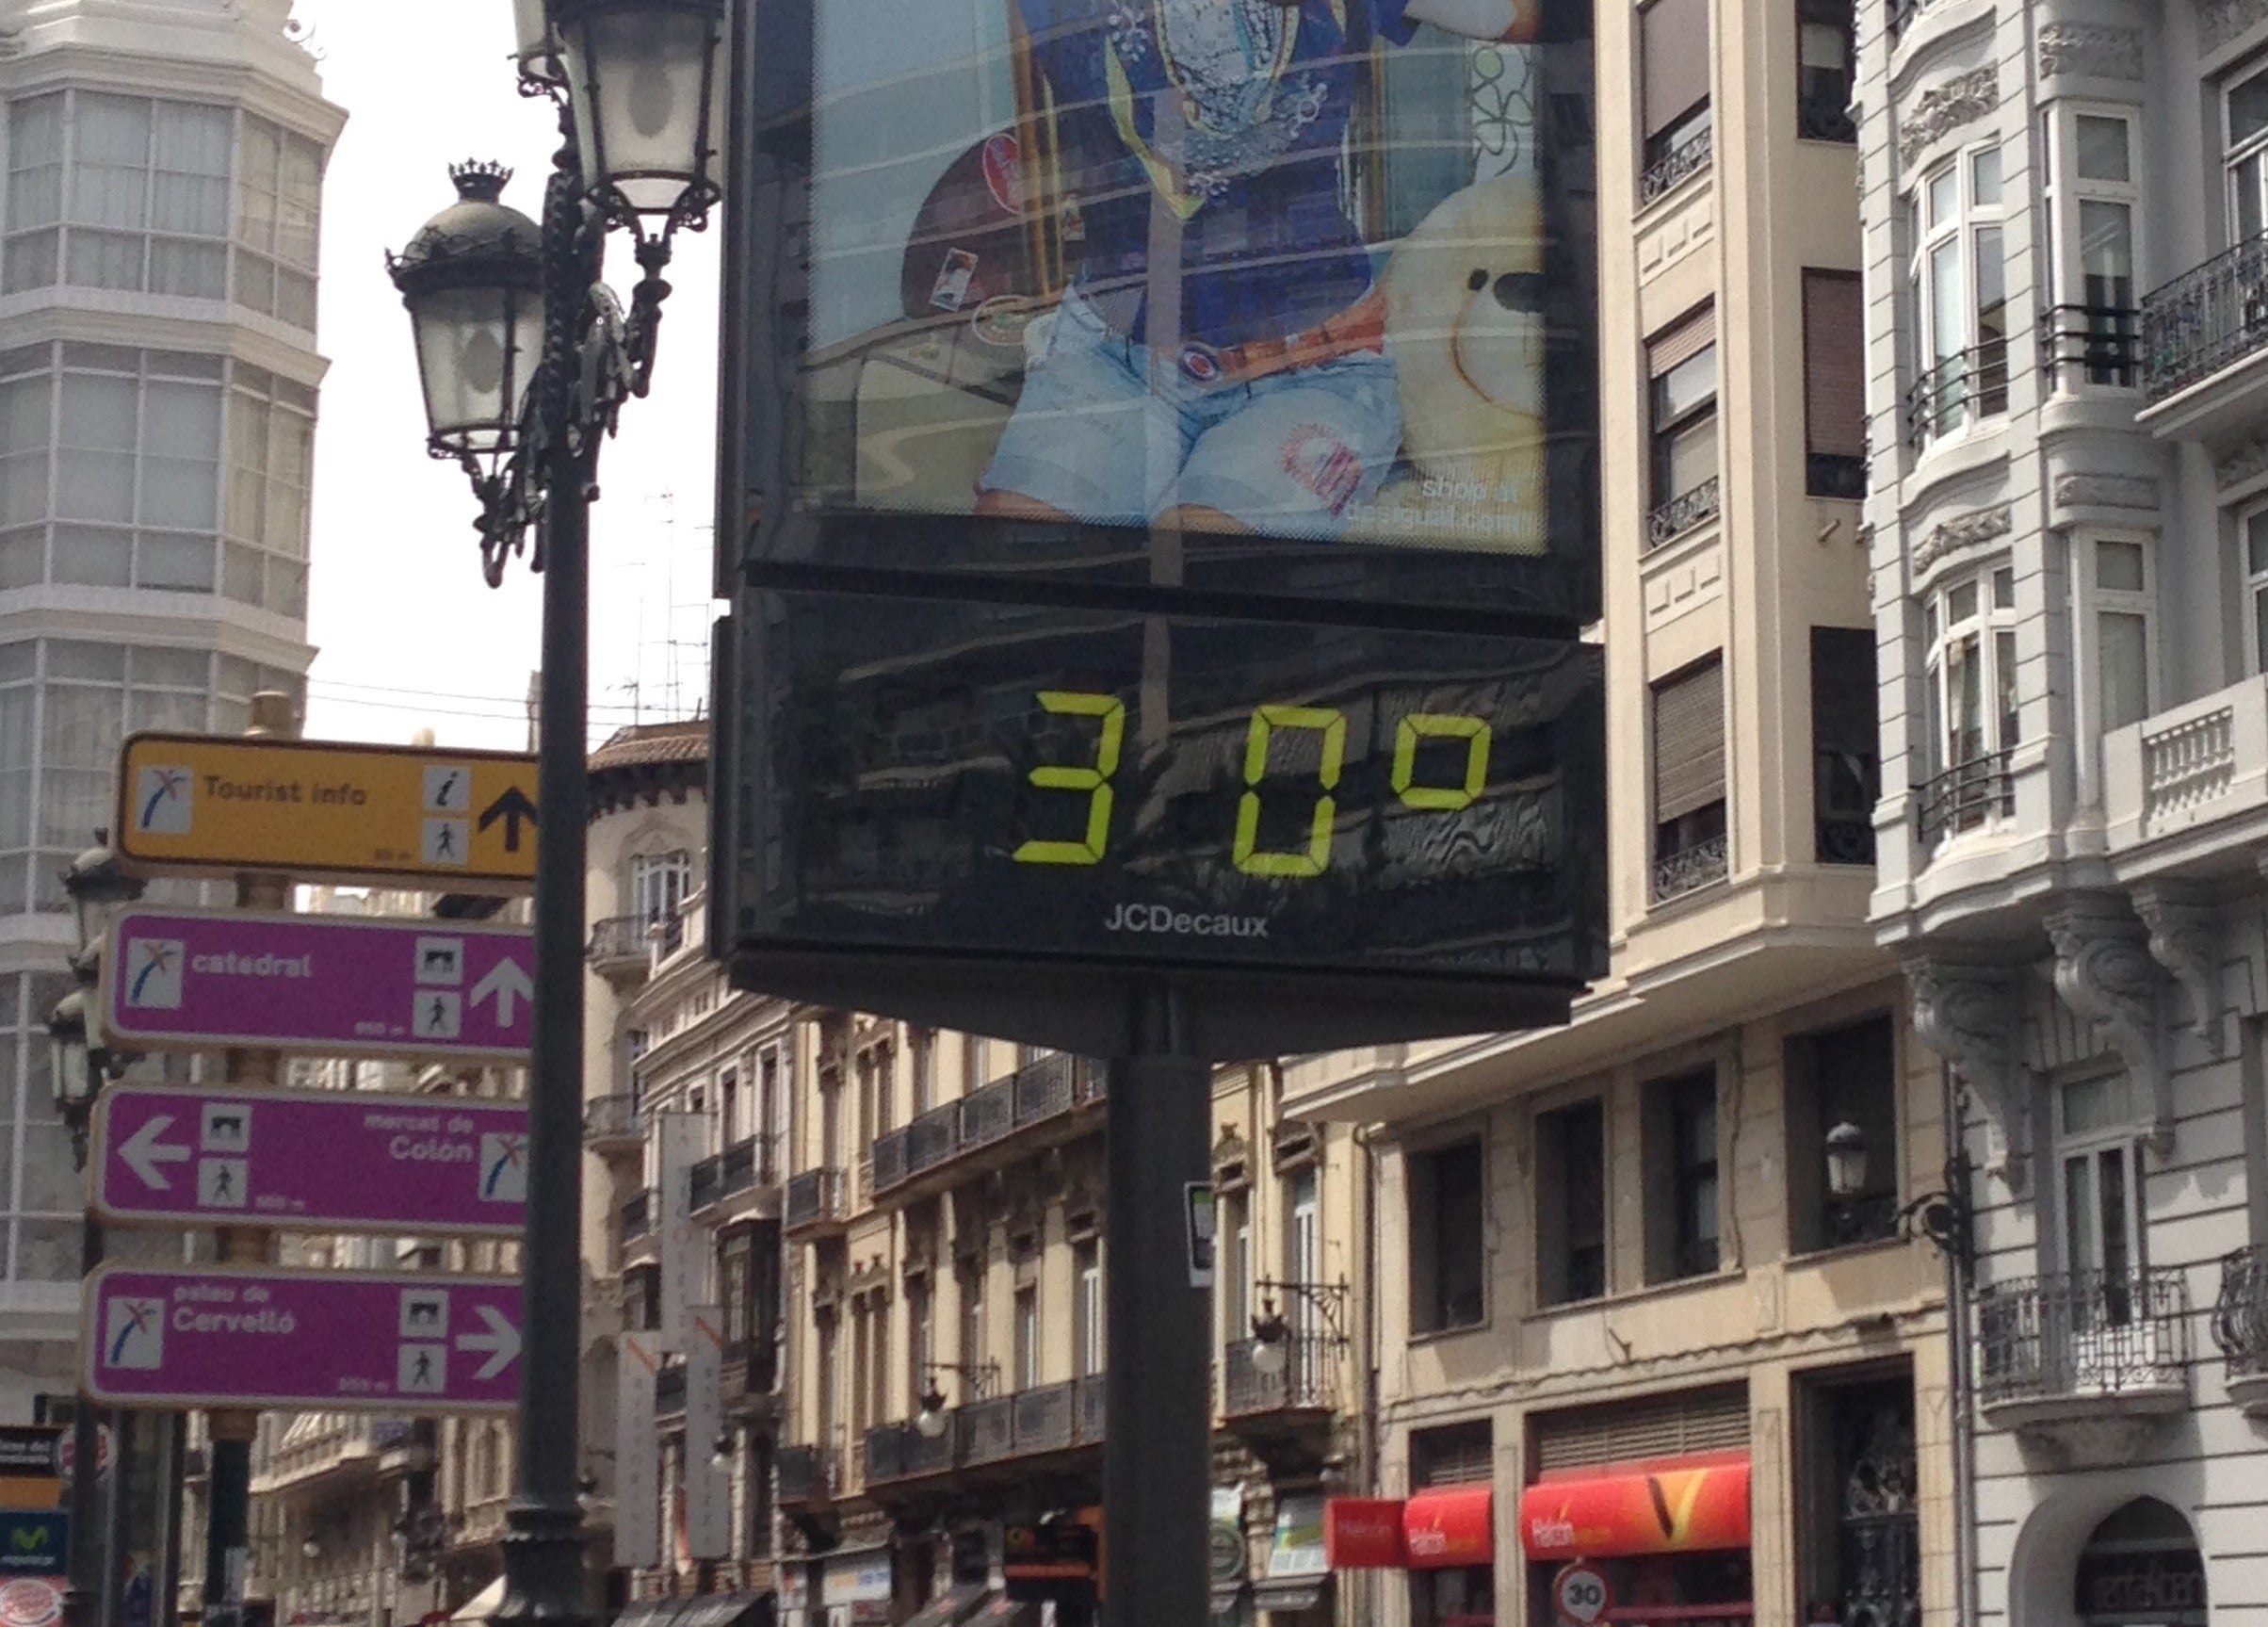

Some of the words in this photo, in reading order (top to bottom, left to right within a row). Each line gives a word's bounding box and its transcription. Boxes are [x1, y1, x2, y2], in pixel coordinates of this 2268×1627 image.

[1422, 476, 1487, 505] shop
[203, 774, 302, 803] Tourist
[312, 782, 367, 805] info
[1105, 903, 1269, 937] JCDecaux
[191, 950, 311, 978] catedral
[388, 1134, 474, 1163] Colón
[1567, 1584, 1602, 1606] 30
